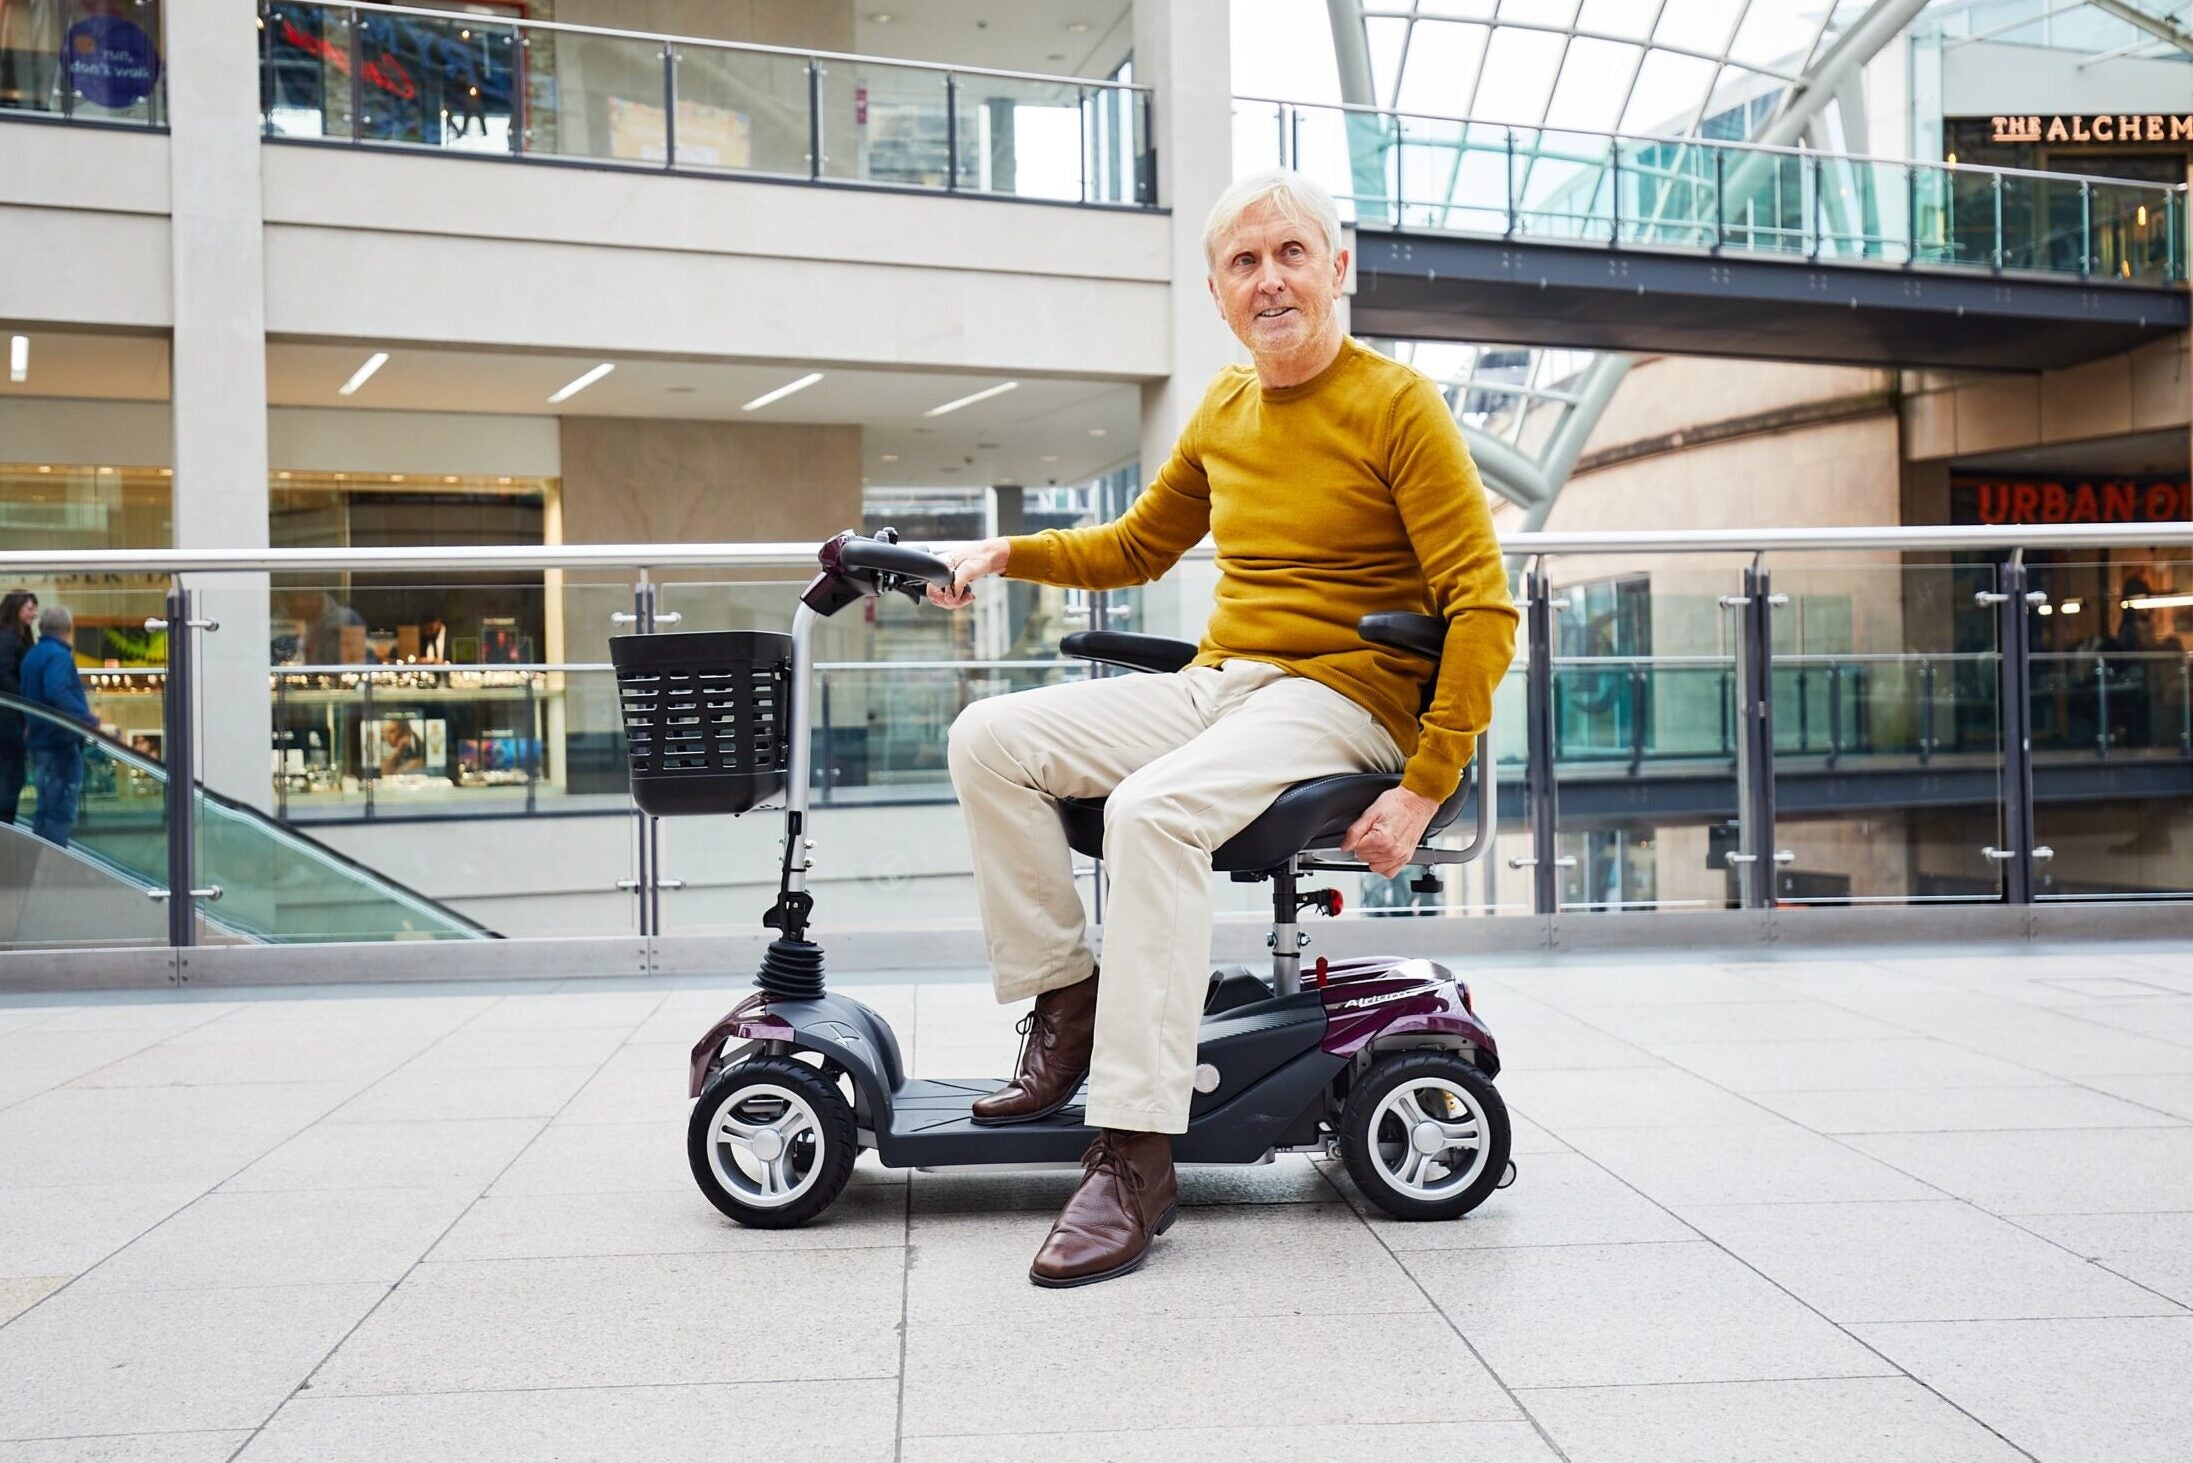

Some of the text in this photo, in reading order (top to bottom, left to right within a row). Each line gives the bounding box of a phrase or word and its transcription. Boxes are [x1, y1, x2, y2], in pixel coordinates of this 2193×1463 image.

[1991, 116, 2193, 141] THE ALCHEM
[1979, 483, 2136, 523] URBAN
